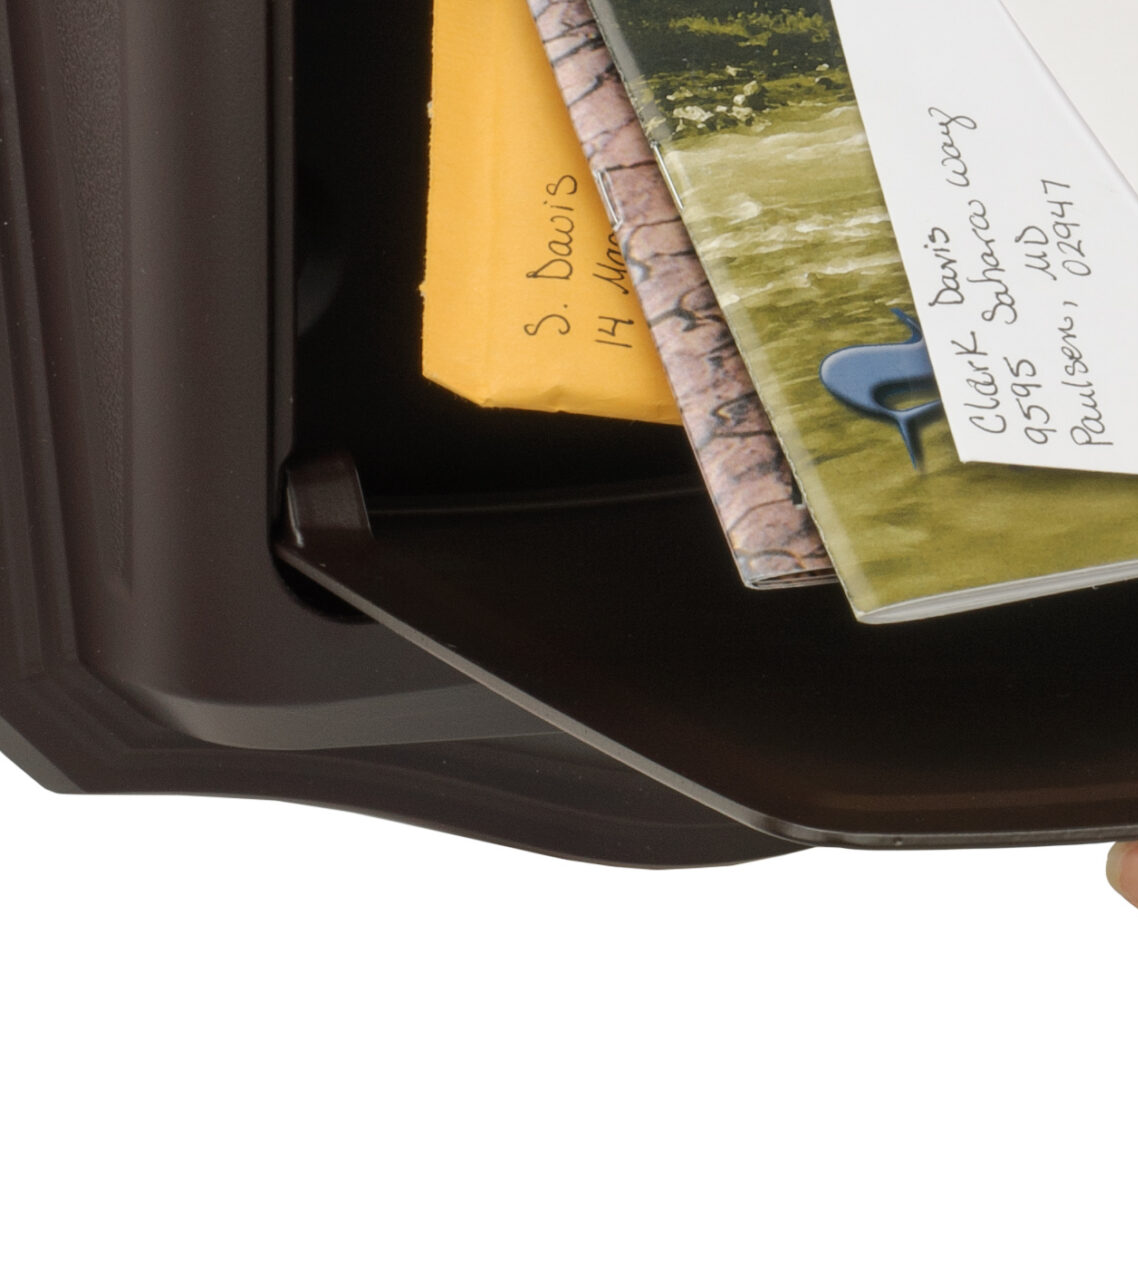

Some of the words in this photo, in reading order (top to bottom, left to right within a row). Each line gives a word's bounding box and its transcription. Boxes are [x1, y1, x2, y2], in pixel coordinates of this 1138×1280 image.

[526, 174, 578, 281] Davis
[924, 226, 964, 308] Davis
[966, 199, 1018, 325] Sahara
[1015, 224, 1058, 280] MD
[1041, 178, 1092, 277] 02947
[523, 303, 571, 336] S.
[594, 315, 635, 349] 14
[951, 330, 1007, 435] Clark
[1003, 356, 1056, 445] 9595
[1061, 301, 1114, 447] Paulsen,
